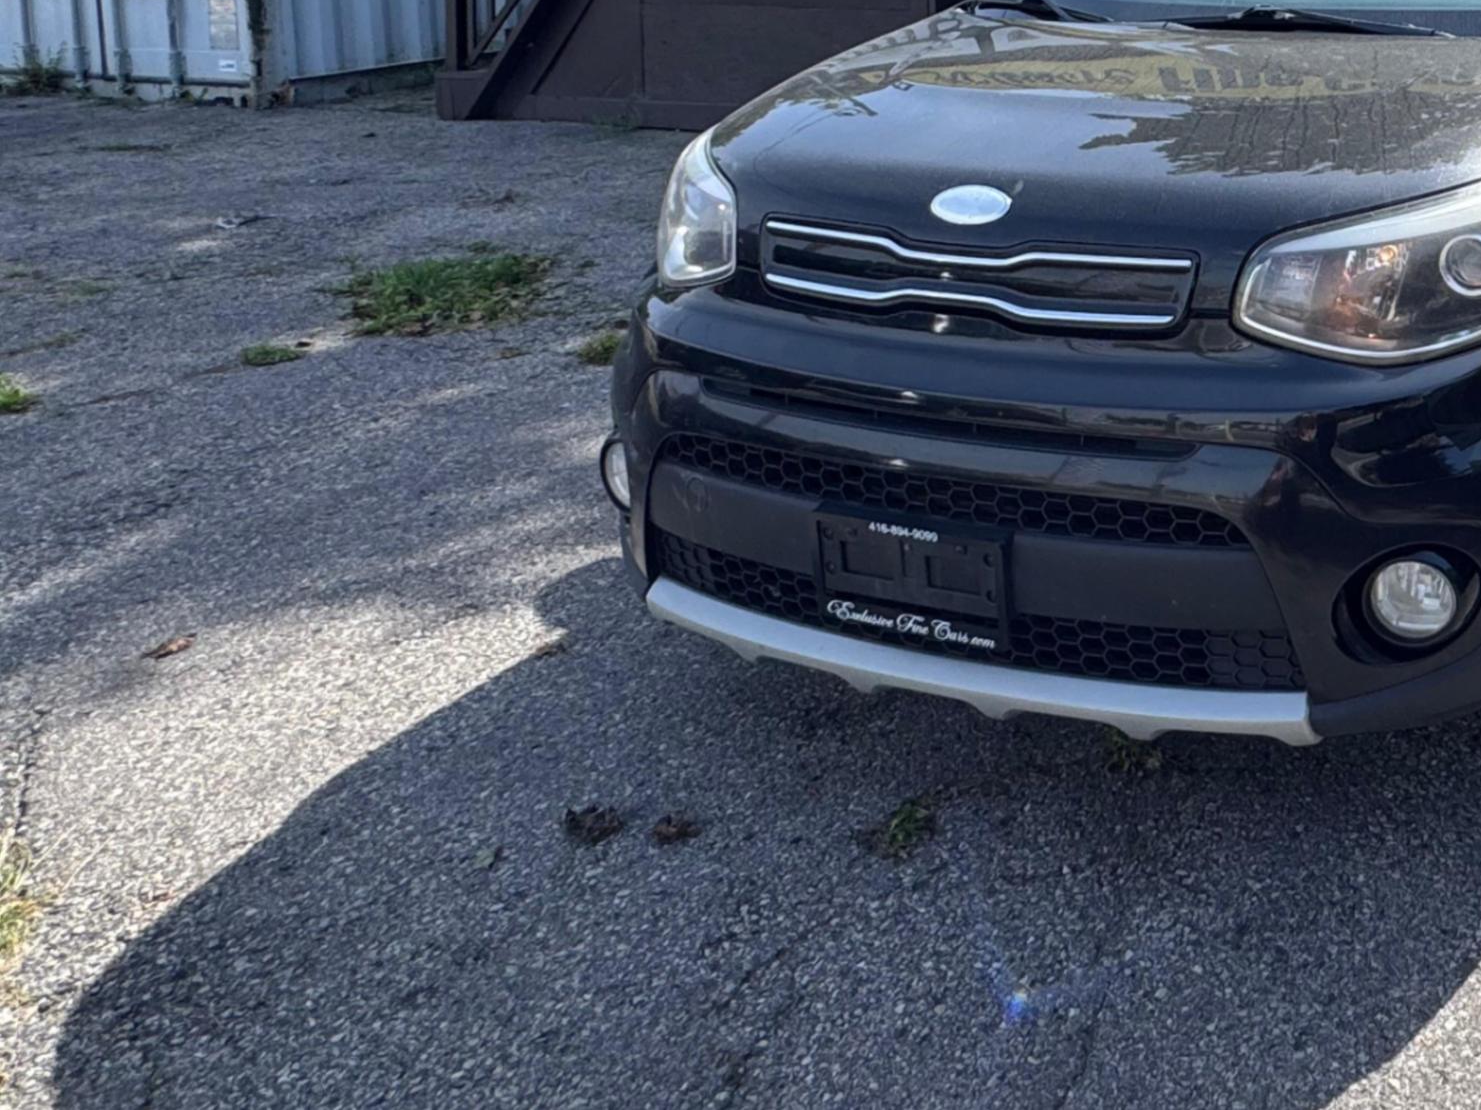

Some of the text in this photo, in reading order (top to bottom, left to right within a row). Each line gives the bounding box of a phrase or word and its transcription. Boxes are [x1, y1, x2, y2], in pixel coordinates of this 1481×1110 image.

[868, 521, 939, 543] 416-894-9099
[827, 599, 894, 627] Exclusive
[896, 613, 929, 635] Fine
